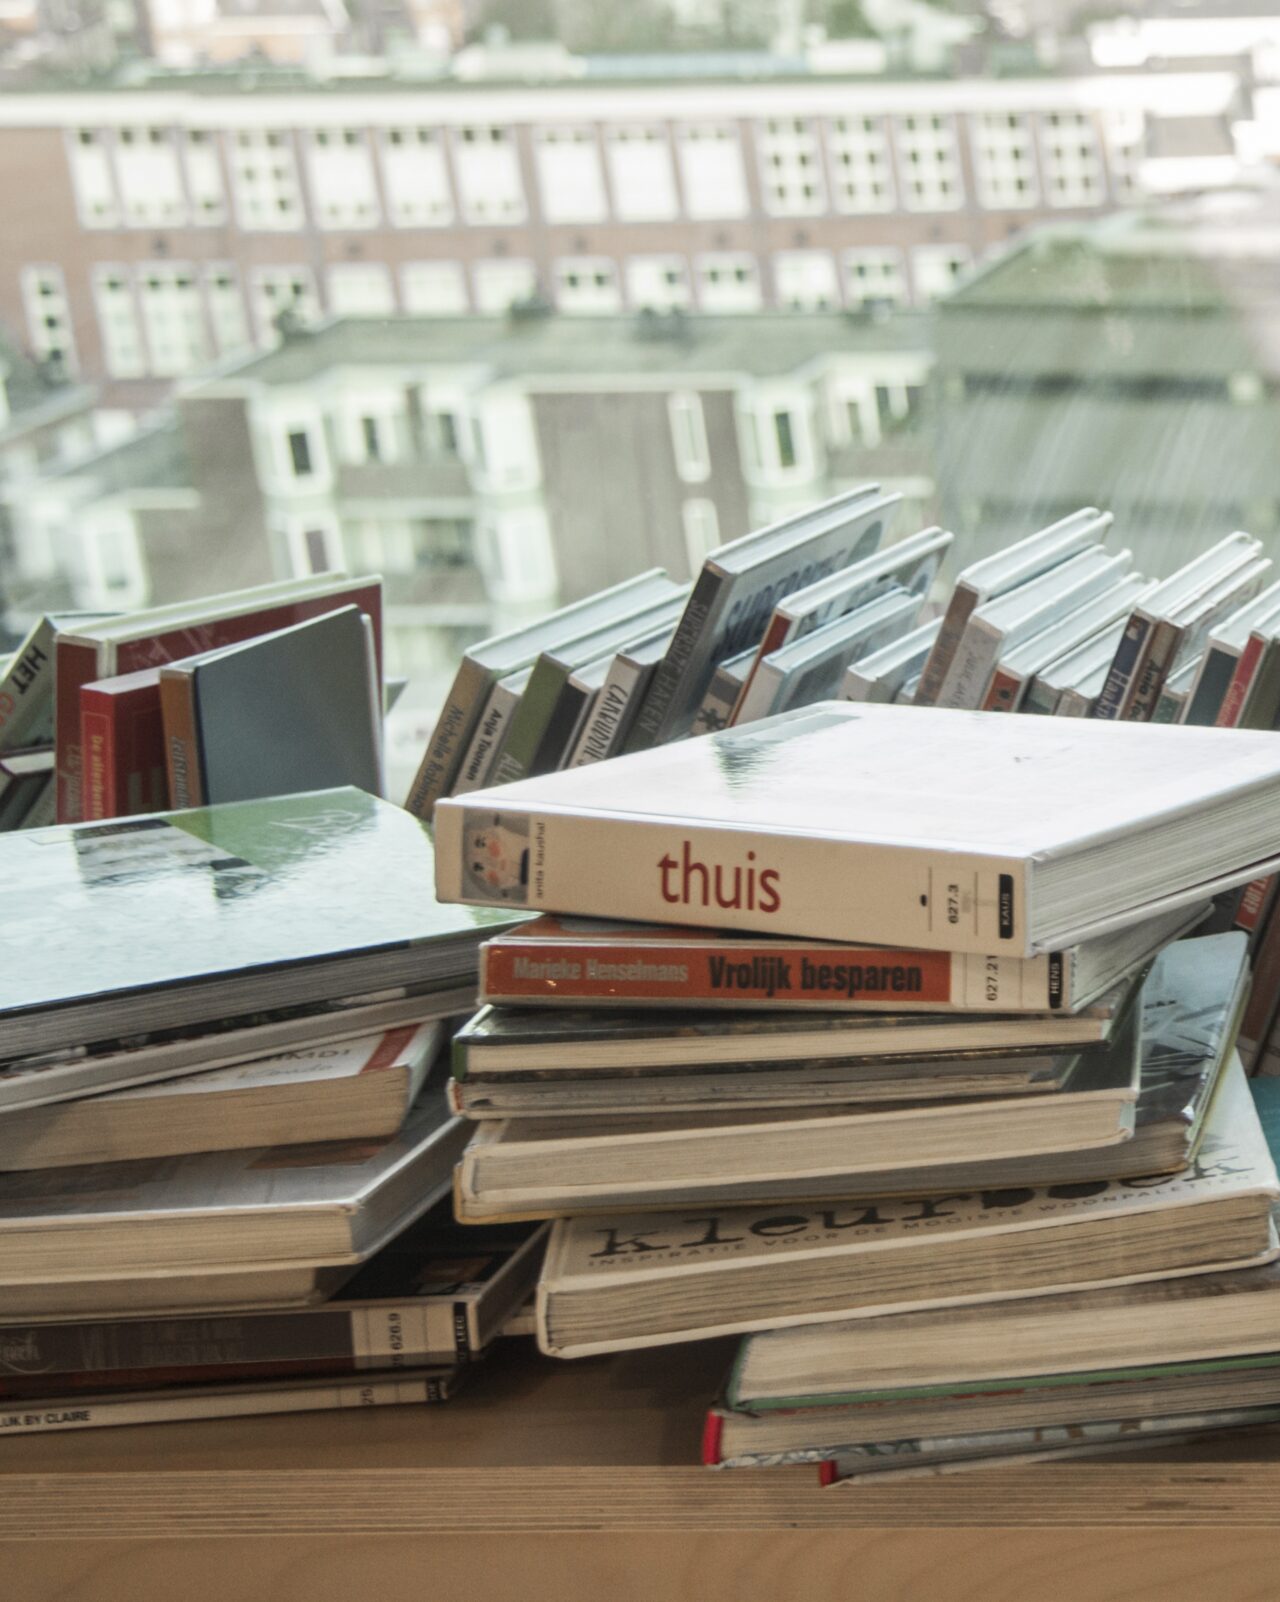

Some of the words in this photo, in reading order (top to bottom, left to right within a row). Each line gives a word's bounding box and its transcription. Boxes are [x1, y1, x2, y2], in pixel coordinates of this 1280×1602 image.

[11, 645, 48, 695] HET
[484, 708, 504, 736] Anja
[640, 675, 678, 733] HAKEN
[433, 706, 464, 762] Michelle
[465, 736, 493, 782] Toonen
[535, 821, 546, 866] kaushal
[536, 869, 546, 899] anita
[657, 840, 781, 913] thuis
[947, 883, 960, 924] 627.3
[1000, 891, 1011, 927] KAUS
[511, 956, 582, 981] Marieke
[585, 958, 690, 983] Henselmans
[709, 956, 791, 997] Vrolijk
[801, 958, 923, 998] besparen
[986, 953, 999, 1002] 627.21
[1050, 962, 1061, 995] HENS
[587, 1243, 748, 1268] INSPIRATIE
[763, 1229, 842, 1249] VOOR
[854, 1226, 888, 1238] DE
[1038, 1174, 1252, 1214] WOONPALETTEN
[25, 1412, 42, 1425] BY
[46, 1410, 91, 1424] CLAIRE
